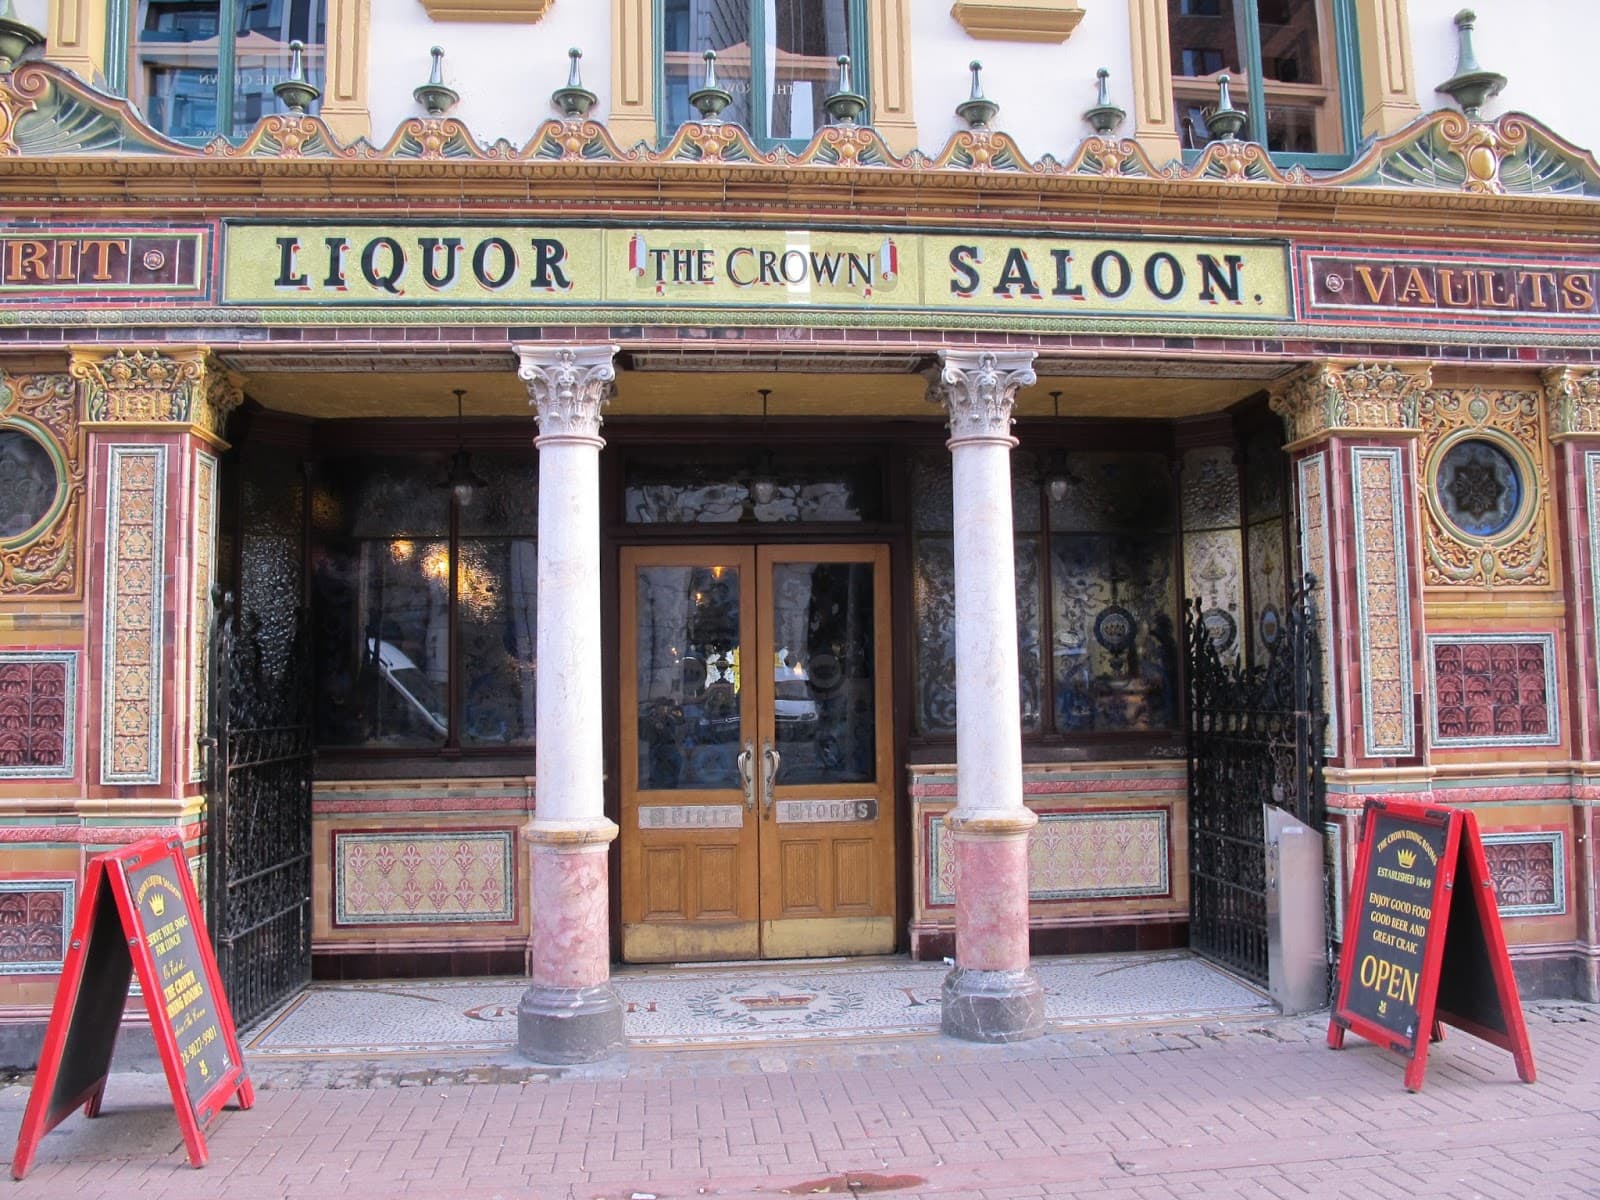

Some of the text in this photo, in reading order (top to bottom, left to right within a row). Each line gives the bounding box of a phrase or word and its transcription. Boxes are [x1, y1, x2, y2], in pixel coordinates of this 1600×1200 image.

[6, 240, 128, 281] RIT
[274, 236, 574, 296] LIQUOR
[649, 247, 876, 288] THE CROWN
[949, 245, 1263, 305] SALOON.
[1354, 264, 1595, 310] VAULTS
[1377, 837, 1389, 853] THE
[1387, 830, 1407, 844] CROWN
[1377, 866, 1432, 889] ESTABLISHED 1849
[1369, 892, 1432, 920] ENJOY GOOD FOOD
[1370, 910, 1426, 938] GOOD BEER AND
[155, 942, 167, 958] FOR
[1373, 929, 1419, 954] GREAT CRAIC
[1360, 954, 1420, 1006] OPEN
